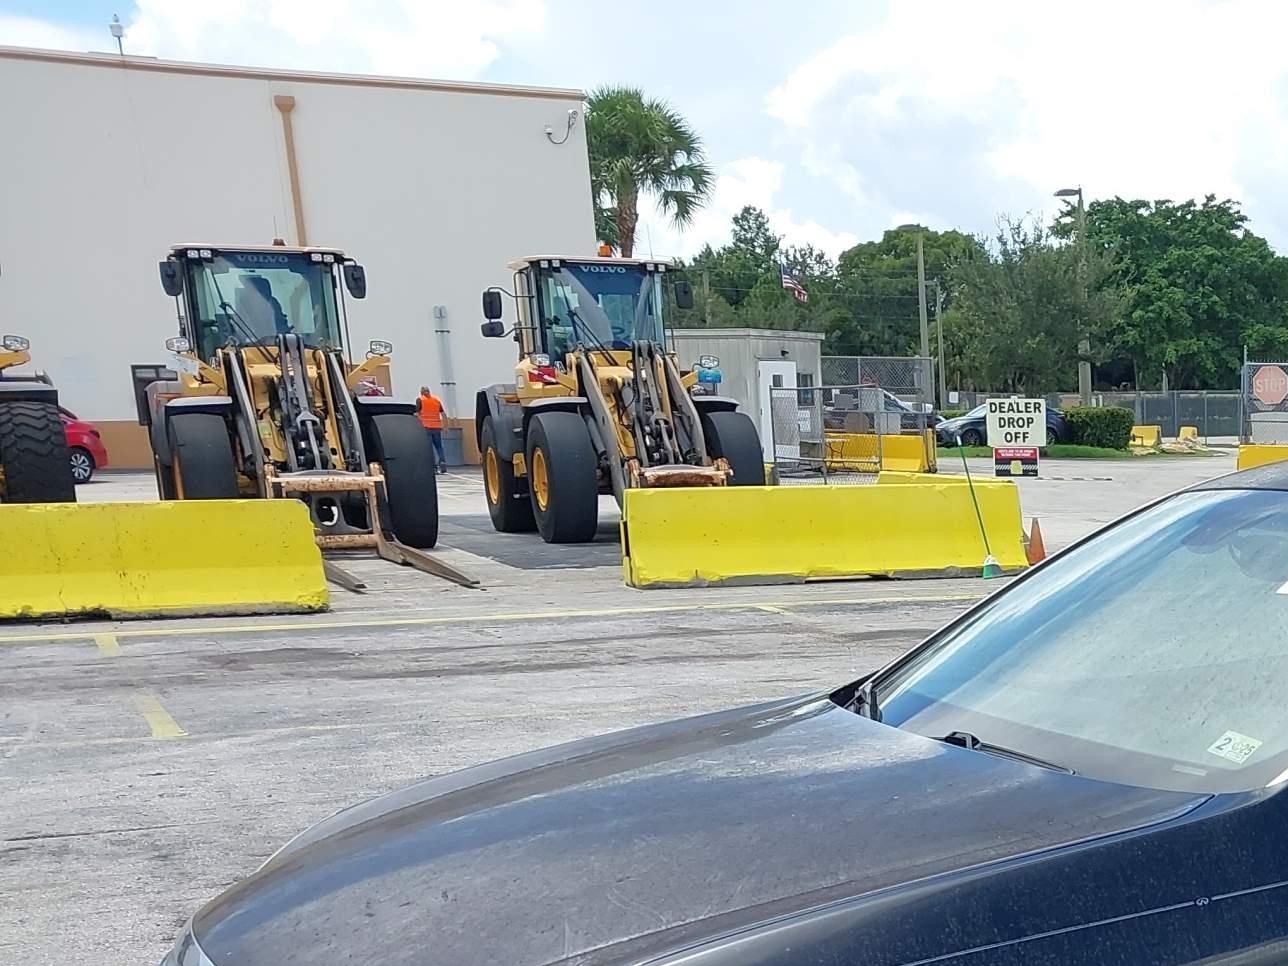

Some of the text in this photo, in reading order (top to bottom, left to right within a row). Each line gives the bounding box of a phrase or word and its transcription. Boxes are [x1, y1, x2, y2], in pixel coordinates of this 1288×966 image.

[237, 255, 289, 263] VOLVO
[580, 265, 626, 273] VOLVO
[1256, 378, 1286, 393] STOP
[989, 402, 1042, 414] DEALER
[998, 417, 1034, 429] DROP
[1004, 431, 1029, 443] OFF
[1214, 737, 1233, 751] 2
